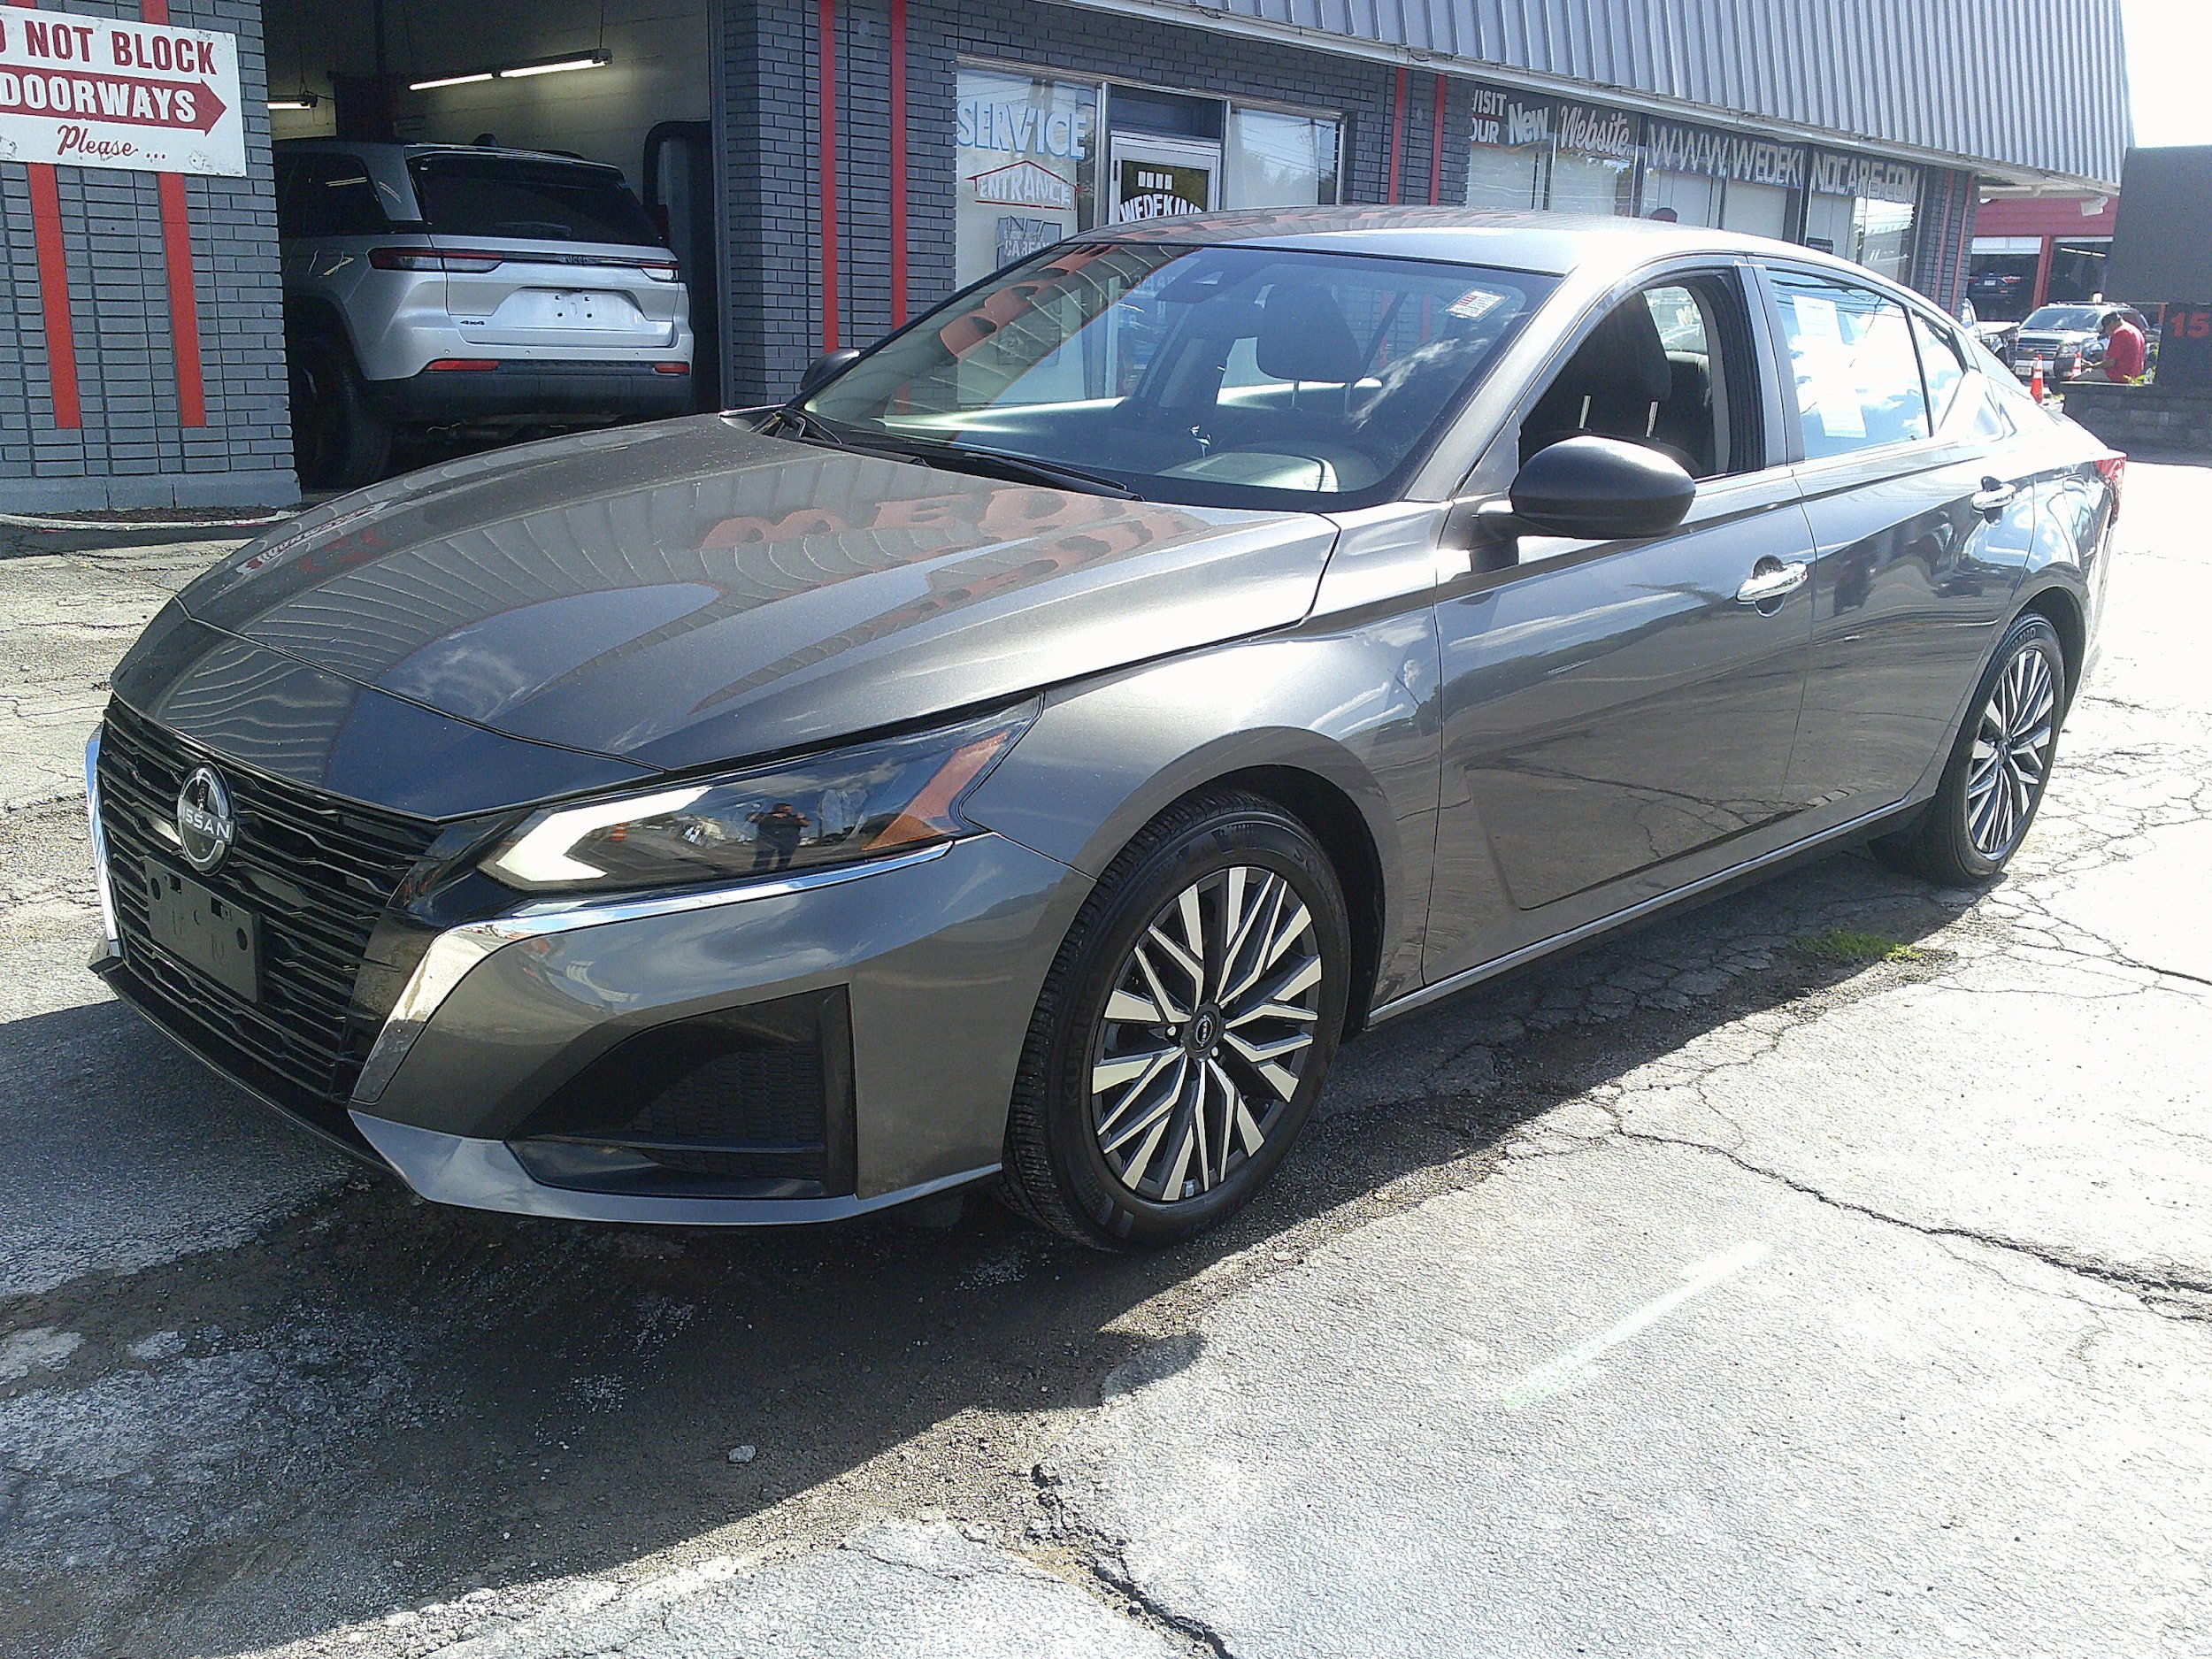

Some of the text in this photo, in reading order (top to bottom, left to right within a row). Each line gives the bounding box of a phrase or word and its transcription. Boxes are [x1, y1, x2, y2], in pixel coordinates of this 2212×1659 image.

[25, 20, 93, 62] NOT
[111, 31, 217, 75] BLOCK
[0, 73, 196, 123] DOORWAYS
[57, 125, 138, 156] Please
[956, 100, 1087, 160] SERVICE
[1508, 102, 1549, 146] New
[979, 165, 1071, 205] ENTRANCE
[2170, 311, 2209, 338] 15
